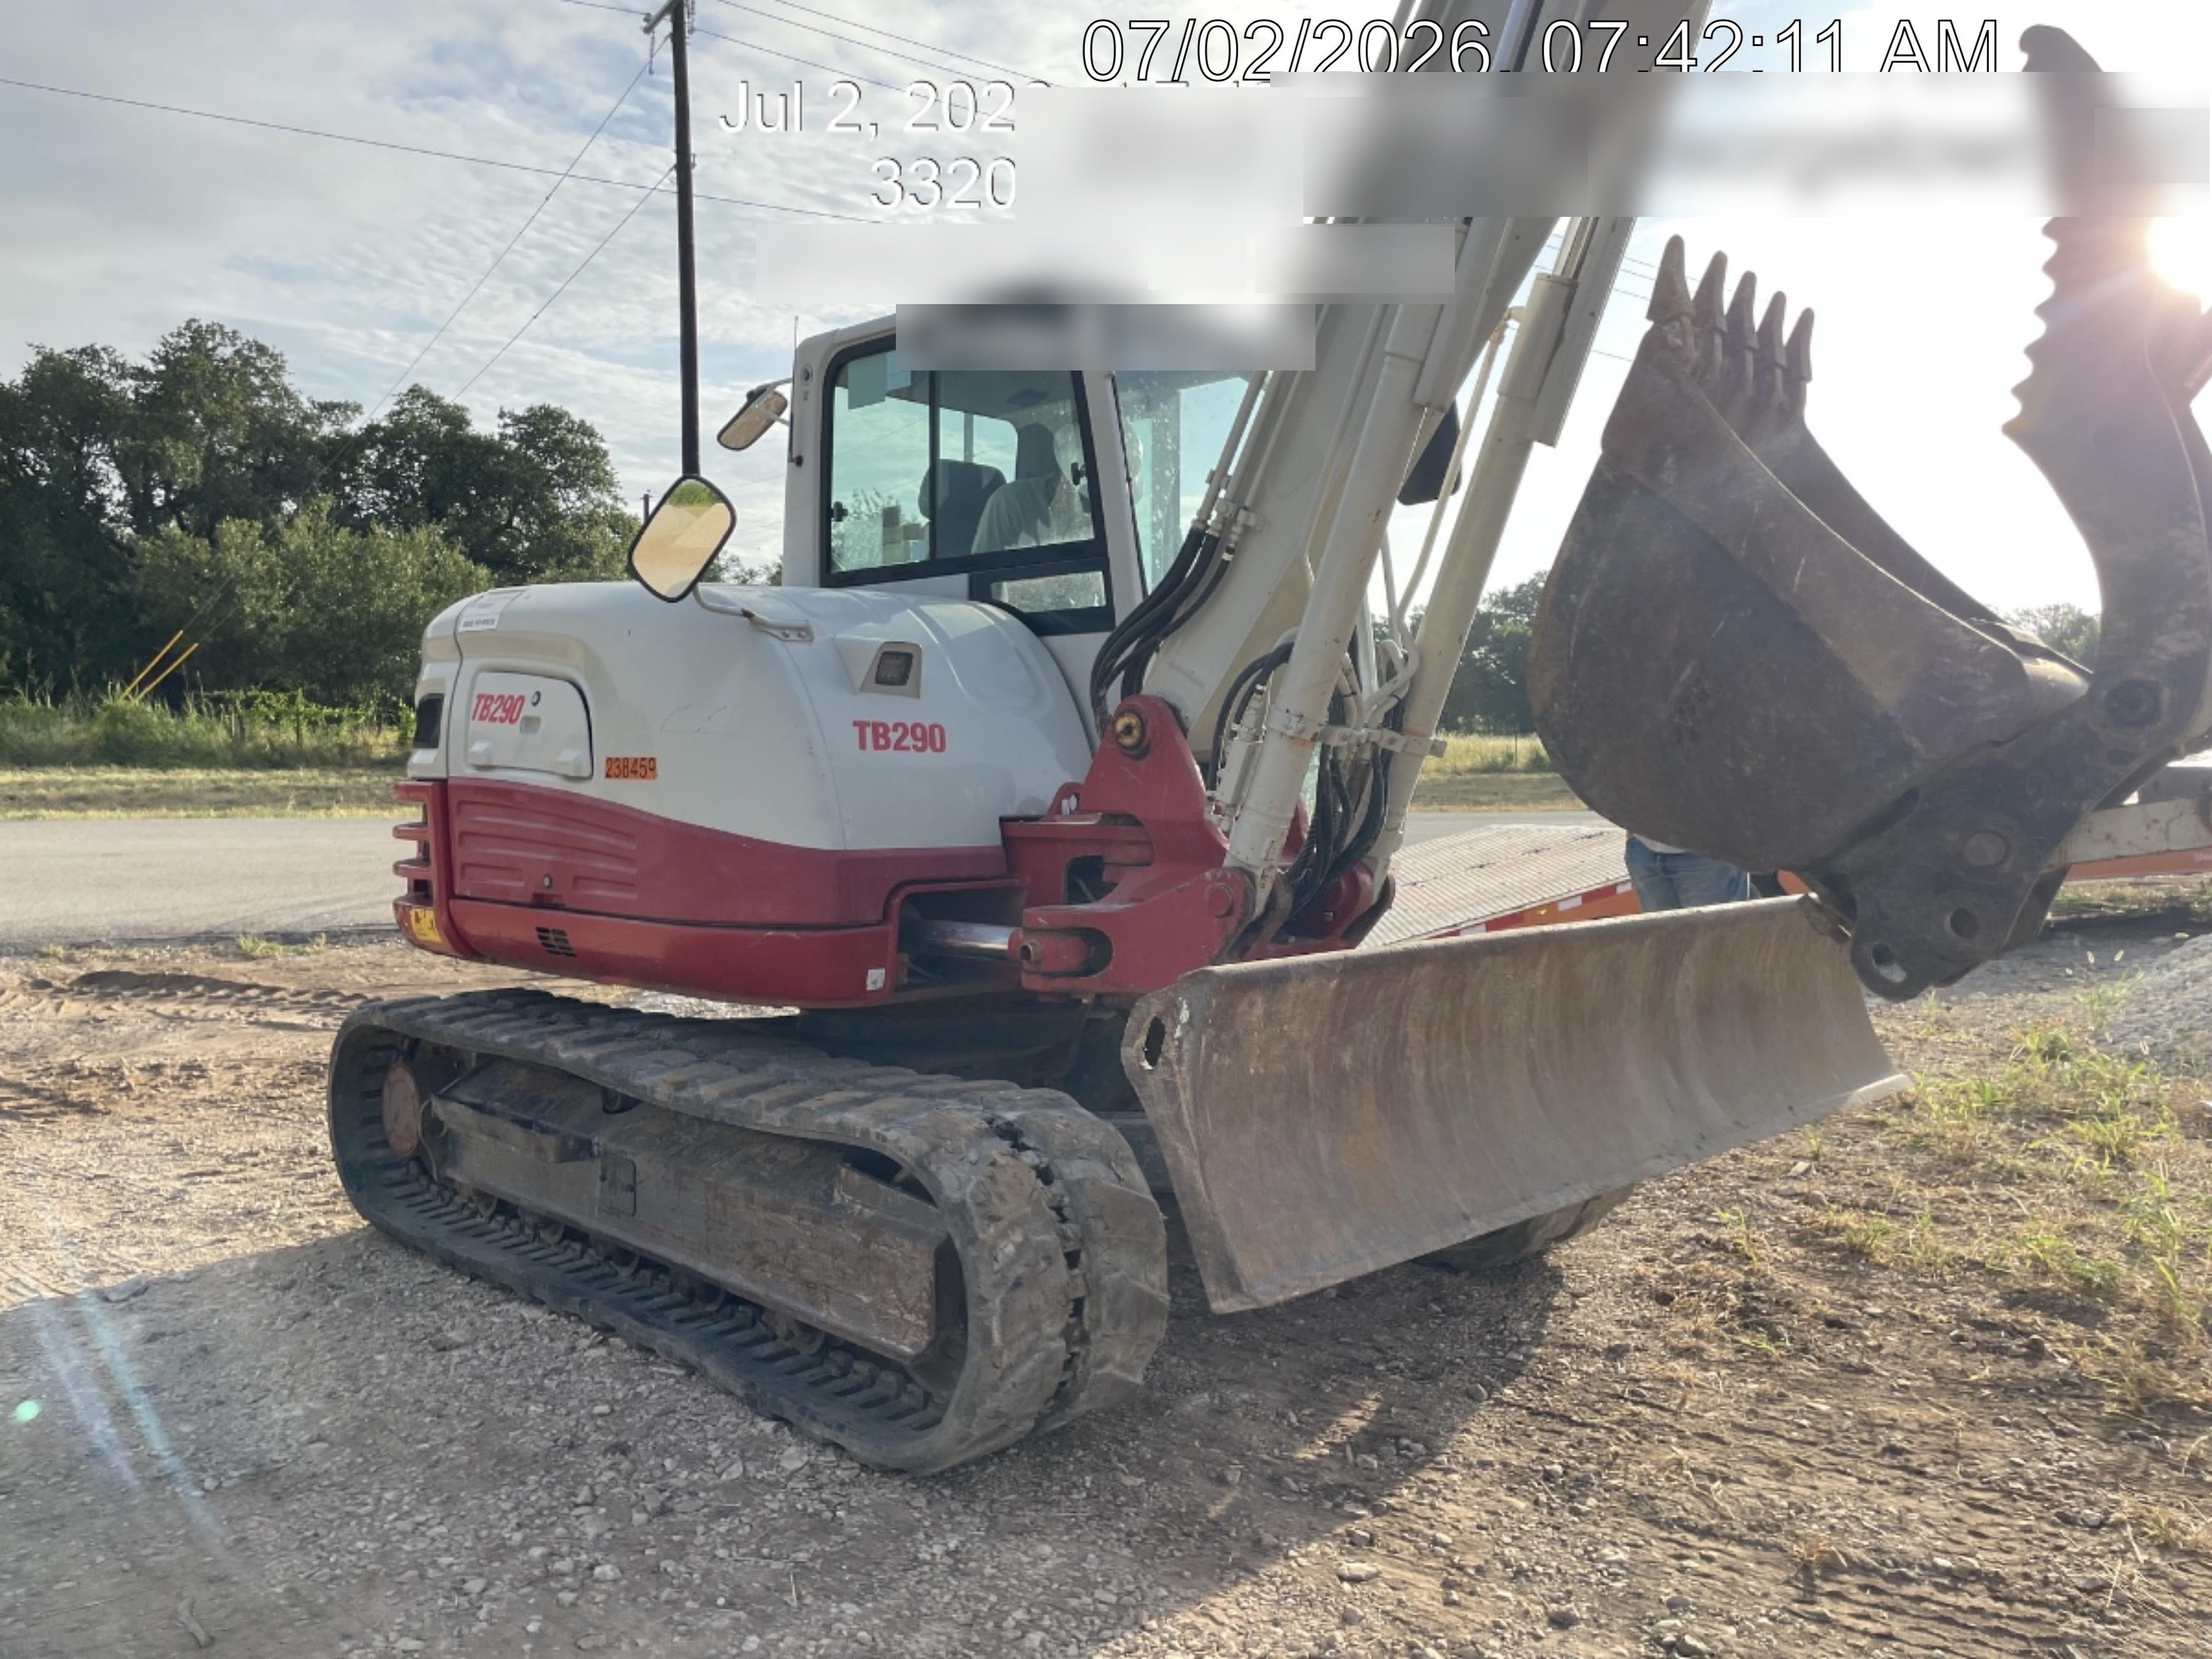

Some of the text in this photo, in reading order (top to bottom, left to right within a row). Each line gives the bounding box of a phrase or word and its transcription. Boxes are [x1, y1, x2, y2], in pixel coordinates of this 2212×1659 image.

[471, 692, 526, 724] TB290
[852, 721, 947, 753] TB290
[605, 756, 656, 779] 238459
